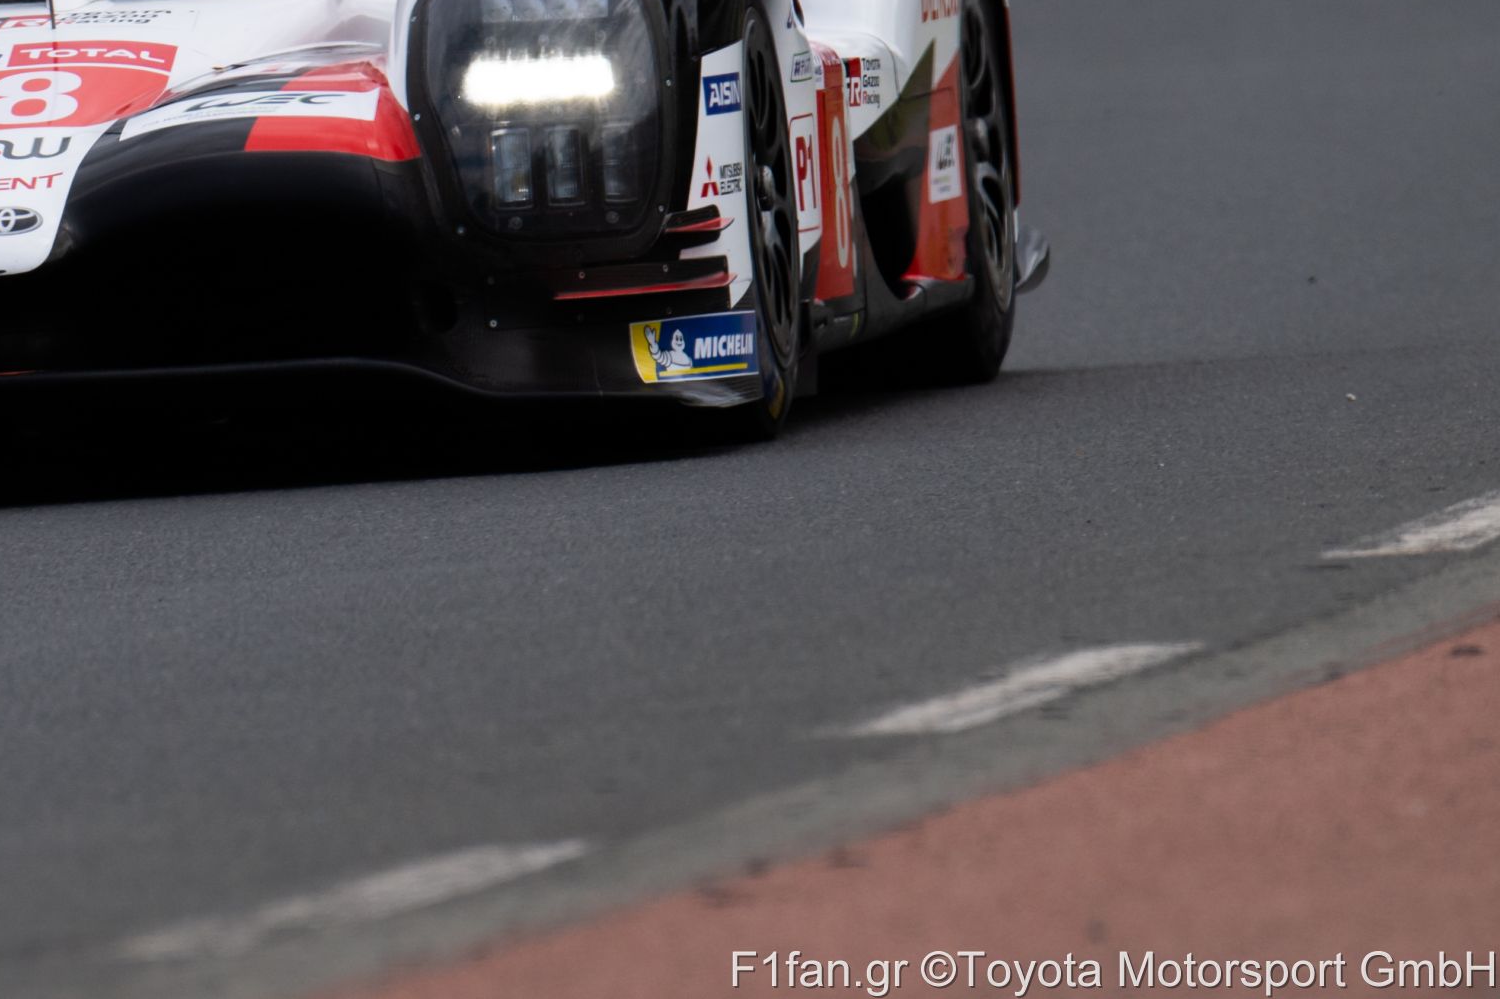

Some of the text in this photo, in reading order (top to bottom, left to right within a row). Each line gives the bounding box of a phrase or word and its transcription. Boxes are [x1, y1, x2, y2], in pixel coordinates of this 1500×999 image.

[19, 47, 166, 64] TOTAL
[708, 78, 741, 109] AISIN
[795, 134, 817, 211] P1
[831, 116, 849, 269] 8
[694, 333, 754, 360] MICHELIN
